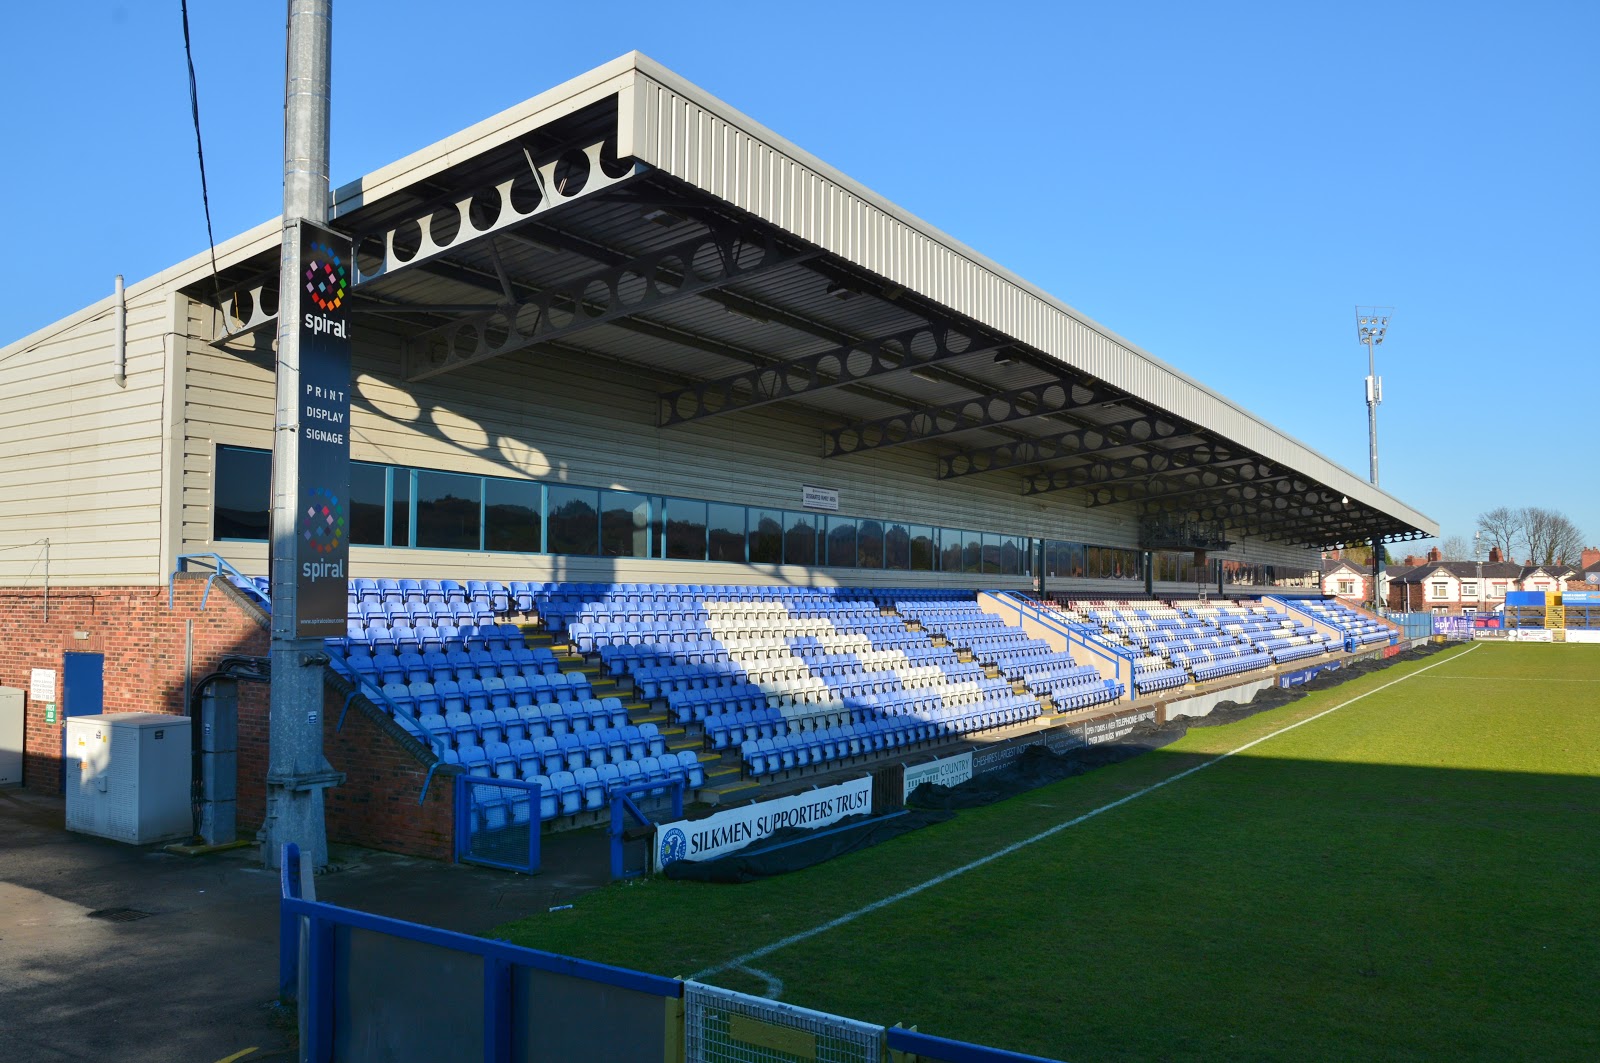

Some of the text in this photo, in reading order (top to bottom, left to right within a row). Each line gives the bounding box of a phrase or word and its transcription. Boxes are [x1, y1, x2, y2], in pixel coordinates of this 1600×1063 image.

[304, 313, 347, 339] spiral
[306, 384, 344, 402] PRINT
[306, 406, 344, 424] DISPLAY
[306, 428, 343, 445] SIGNAGE
[302, 557, 344, 582] spiral
[940, 758, 970, 776] COUNTRY
[690, 819, 752, 855] SILKMEN
[756, 798, 833, 837] SUPPORTERS
[835, 789, 869, 814] TRUST
